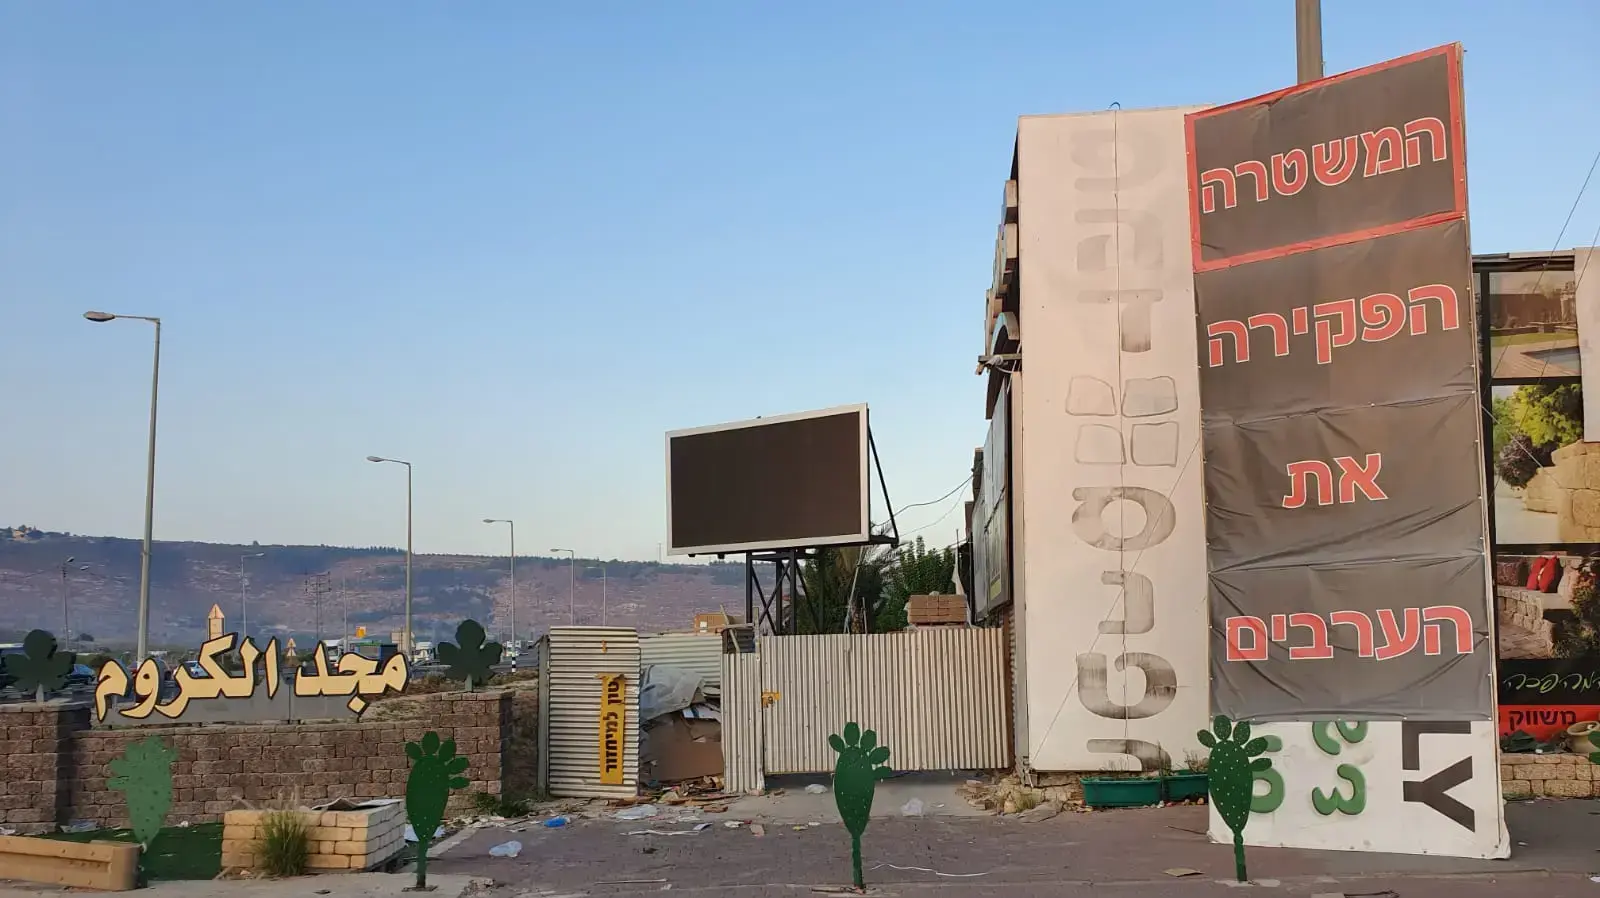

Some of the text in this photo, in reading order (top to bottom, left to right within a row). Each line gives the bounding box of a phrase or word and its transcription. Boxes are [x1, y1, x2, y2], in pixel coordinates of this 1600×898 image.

[1200, 116, 1448, 214] המשטרה
[1207, 283, 1460, 368] הפקירה
[1281, 452, 1389, 509] את
[1225, 605, 1474, 662] הערבים
[94, 631, 411, 723] مجد الكروم
[602, 712, 619, 774] למיחזור
[1508, 710, 1578, 732] משווק
